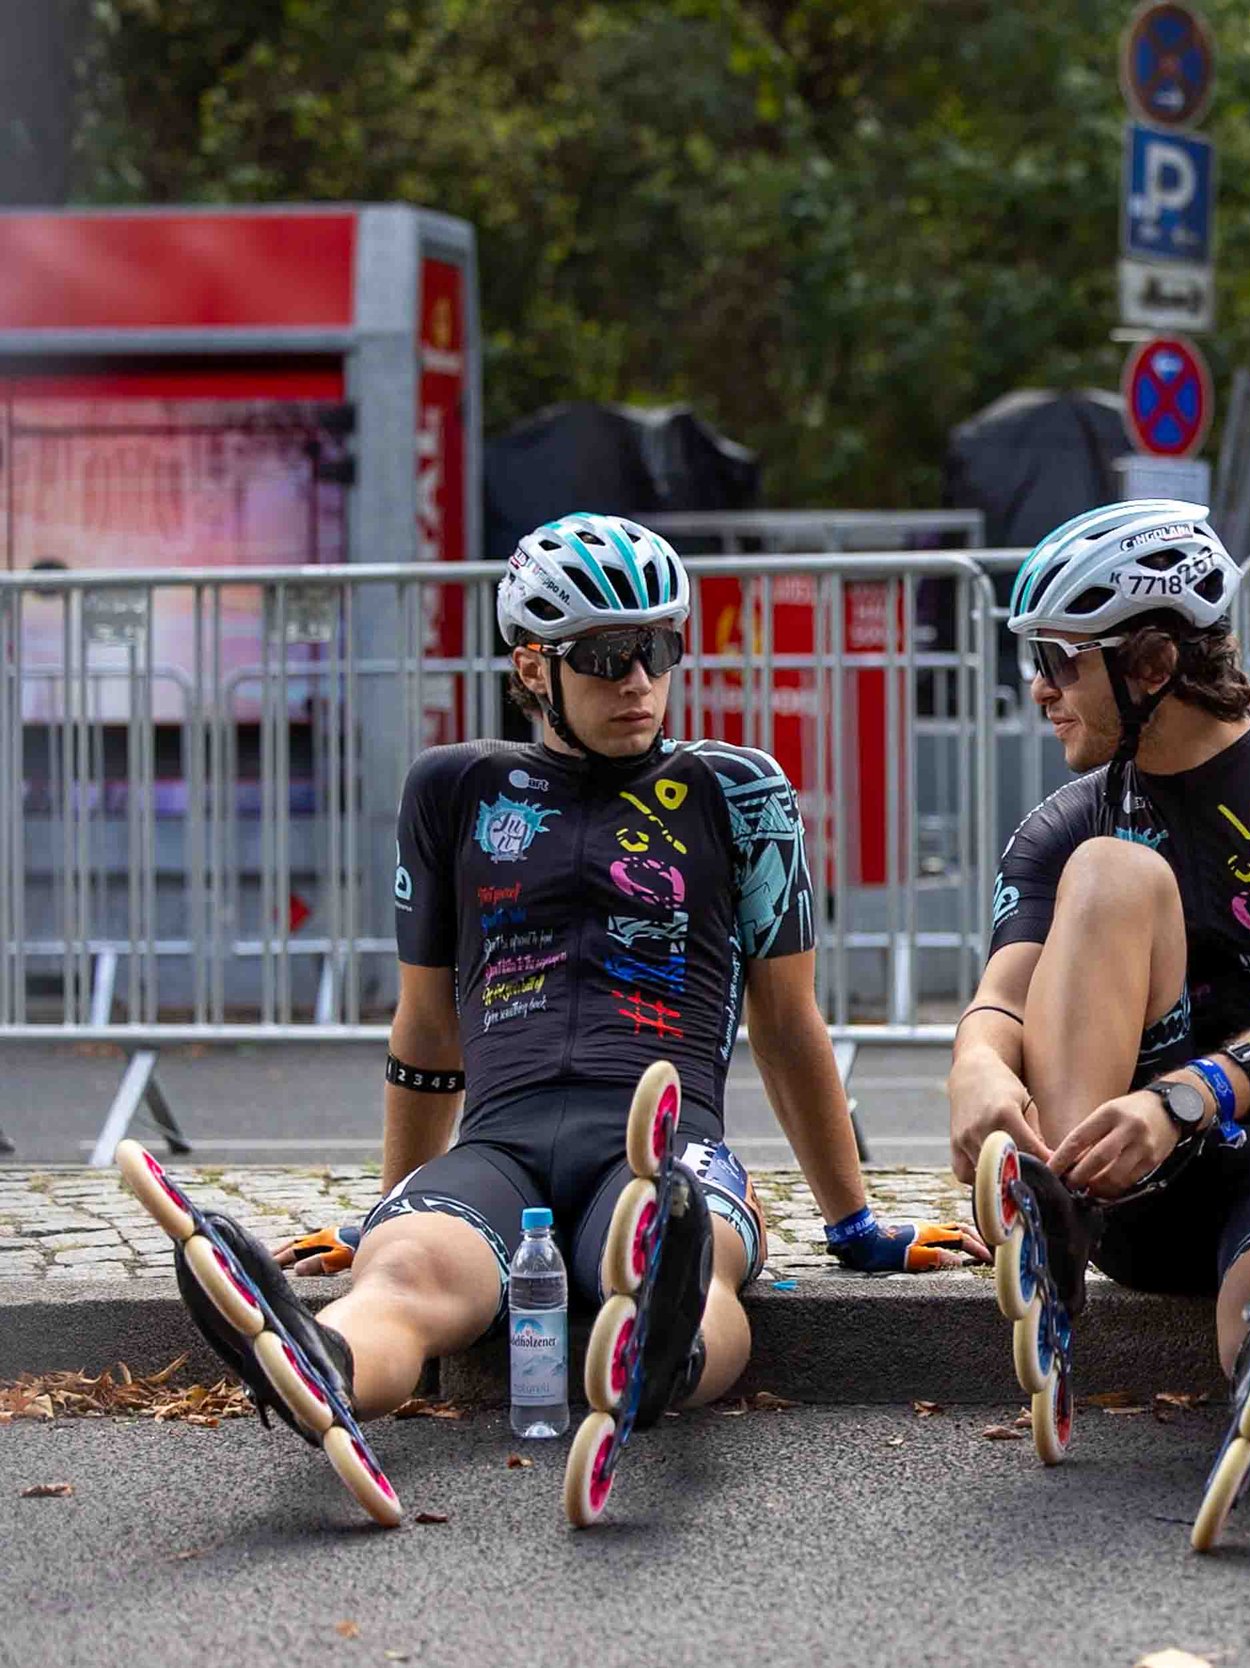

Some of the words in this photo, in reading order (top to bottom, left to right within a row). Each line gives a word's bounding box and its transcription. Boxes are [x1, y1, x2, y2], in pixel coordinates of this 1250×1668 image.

[1145, 143, 1197, 219] P
[1128, 575, 1183, 595] 7718
[558, 590, 571, 605] M.
[510, 1334, 556, 1348] delholzener
